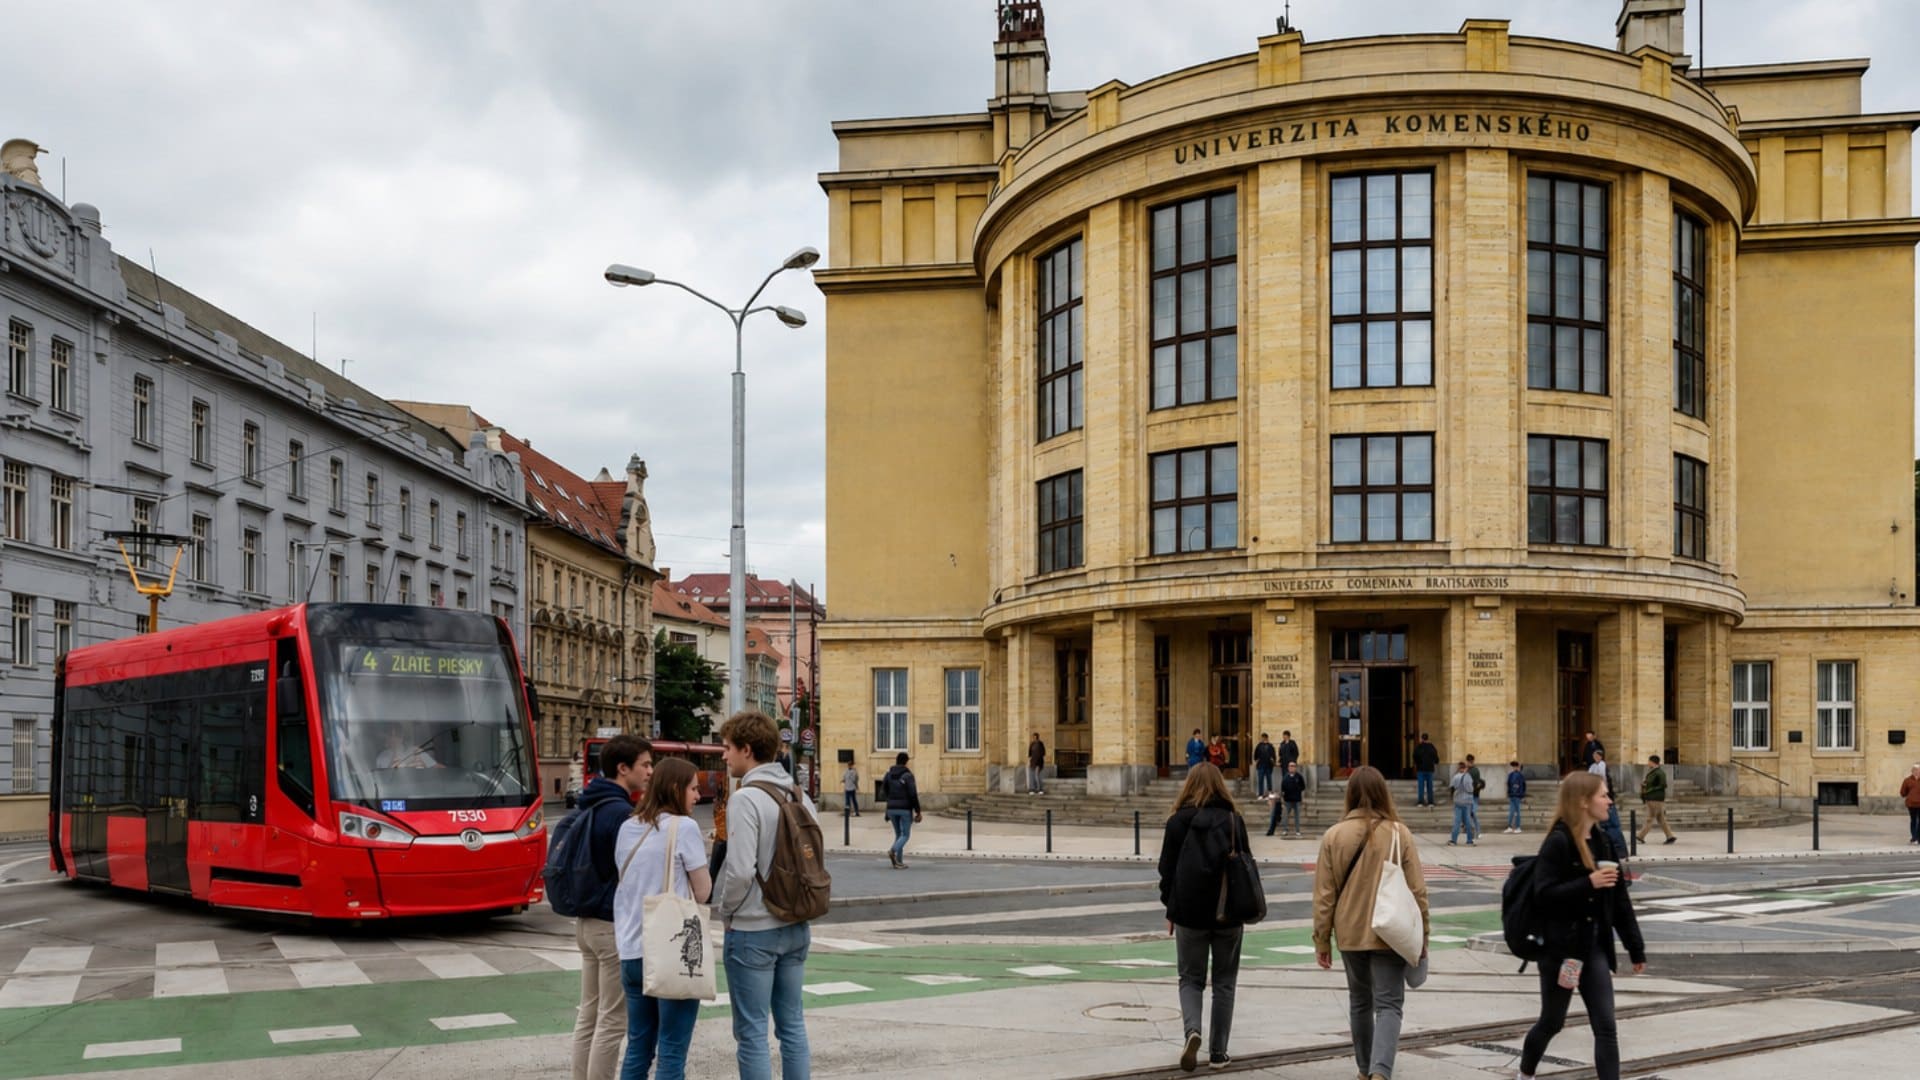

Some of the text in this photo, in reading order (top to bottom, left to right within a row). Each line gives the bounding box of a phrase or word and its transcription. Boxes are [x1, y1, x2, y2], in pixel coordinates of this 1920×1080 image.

[1175, 112, 1590, 164] UNIVERZITA KOMENSKÉHO
[1347, 577, 1413, 590] COMENIANA
[363, 650, 483, 675] 4 ZLATE PIESKY
[447, 809, 487, 823] 7530
